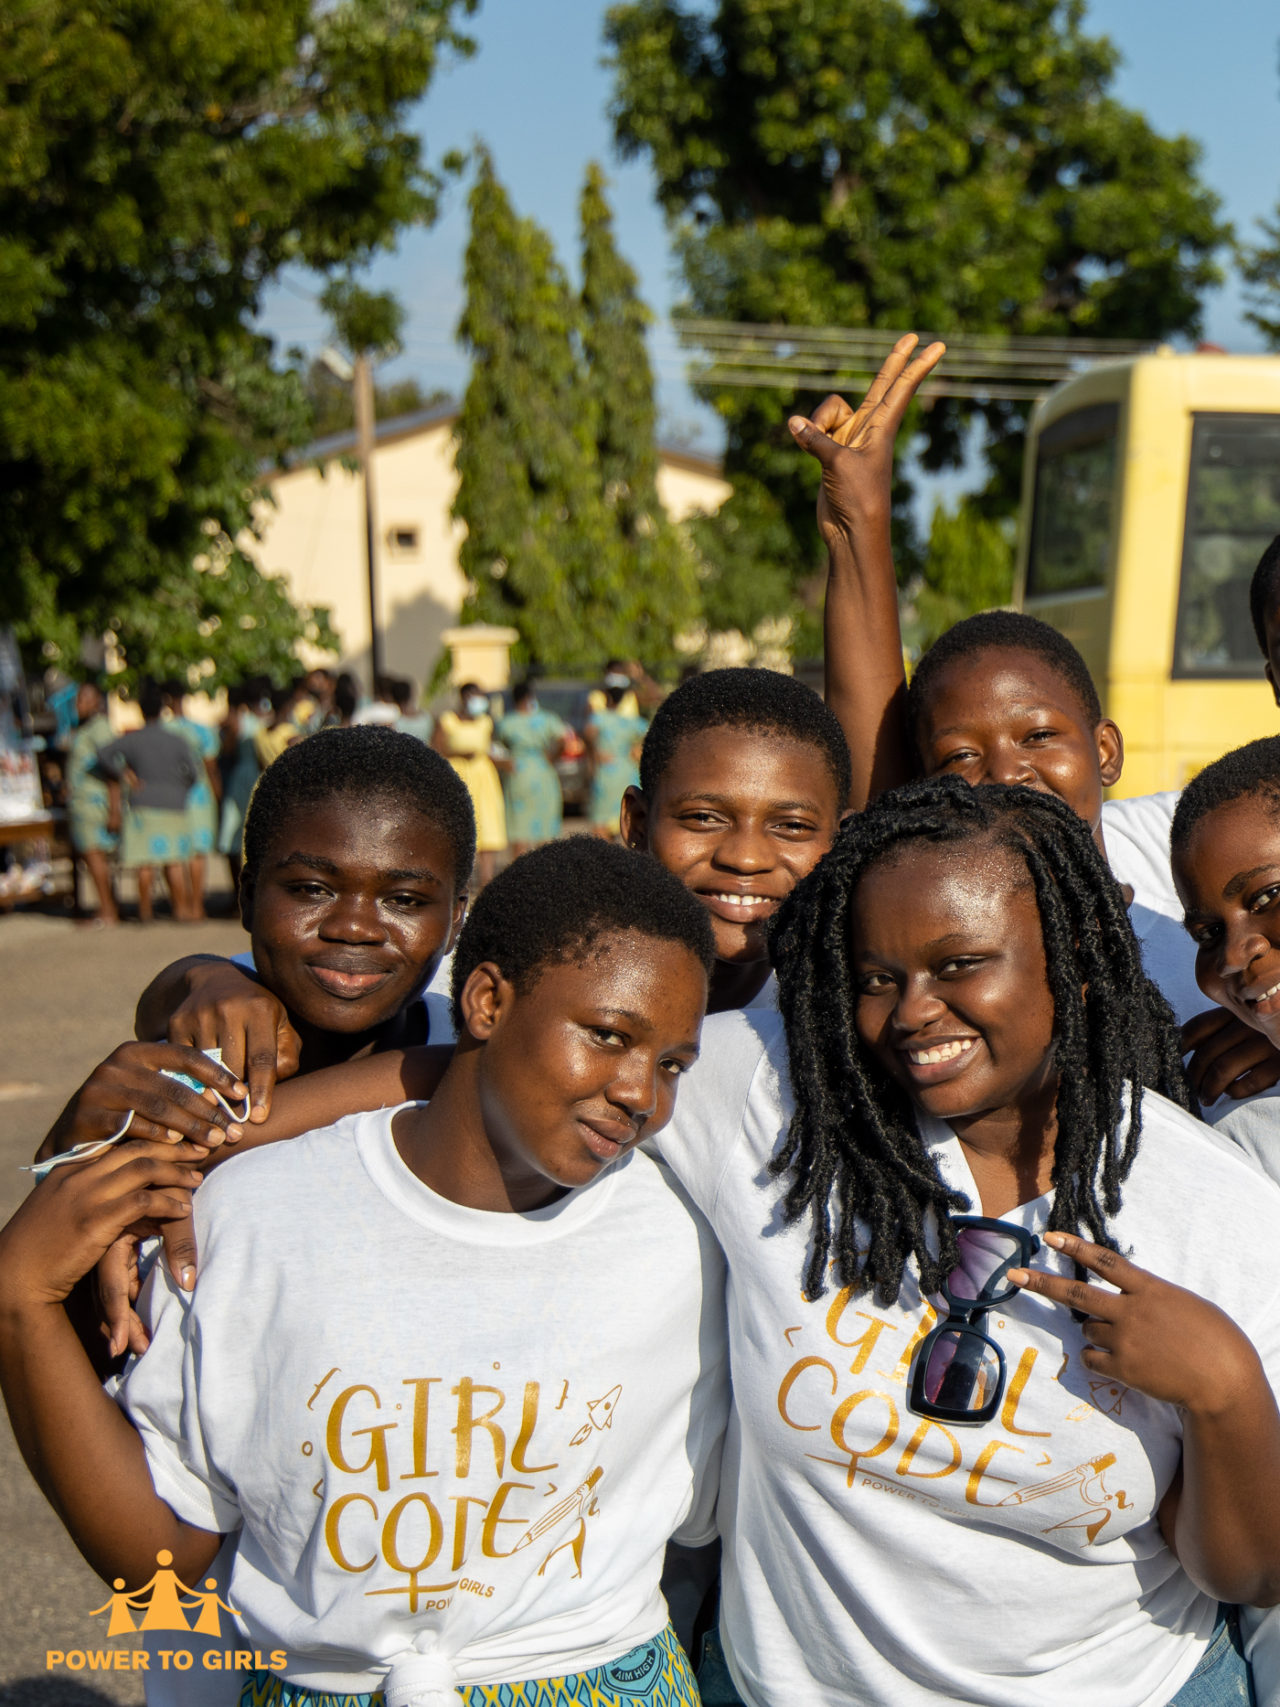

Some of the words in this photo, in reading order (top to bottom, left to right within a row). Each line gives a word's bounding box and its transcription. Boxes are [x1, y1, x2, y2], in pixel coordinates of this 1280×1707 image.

[326, 1376, 559, 1492] GIRL
[777, 1356, 1026, 1508] CODE
[861, 1477, 917, 1500] POWER
[459, 1577, 495, 1598] GIRLS
[616, 1671, 633, 1681] AIM
[635, 1656, 655, 1678] HIGH
